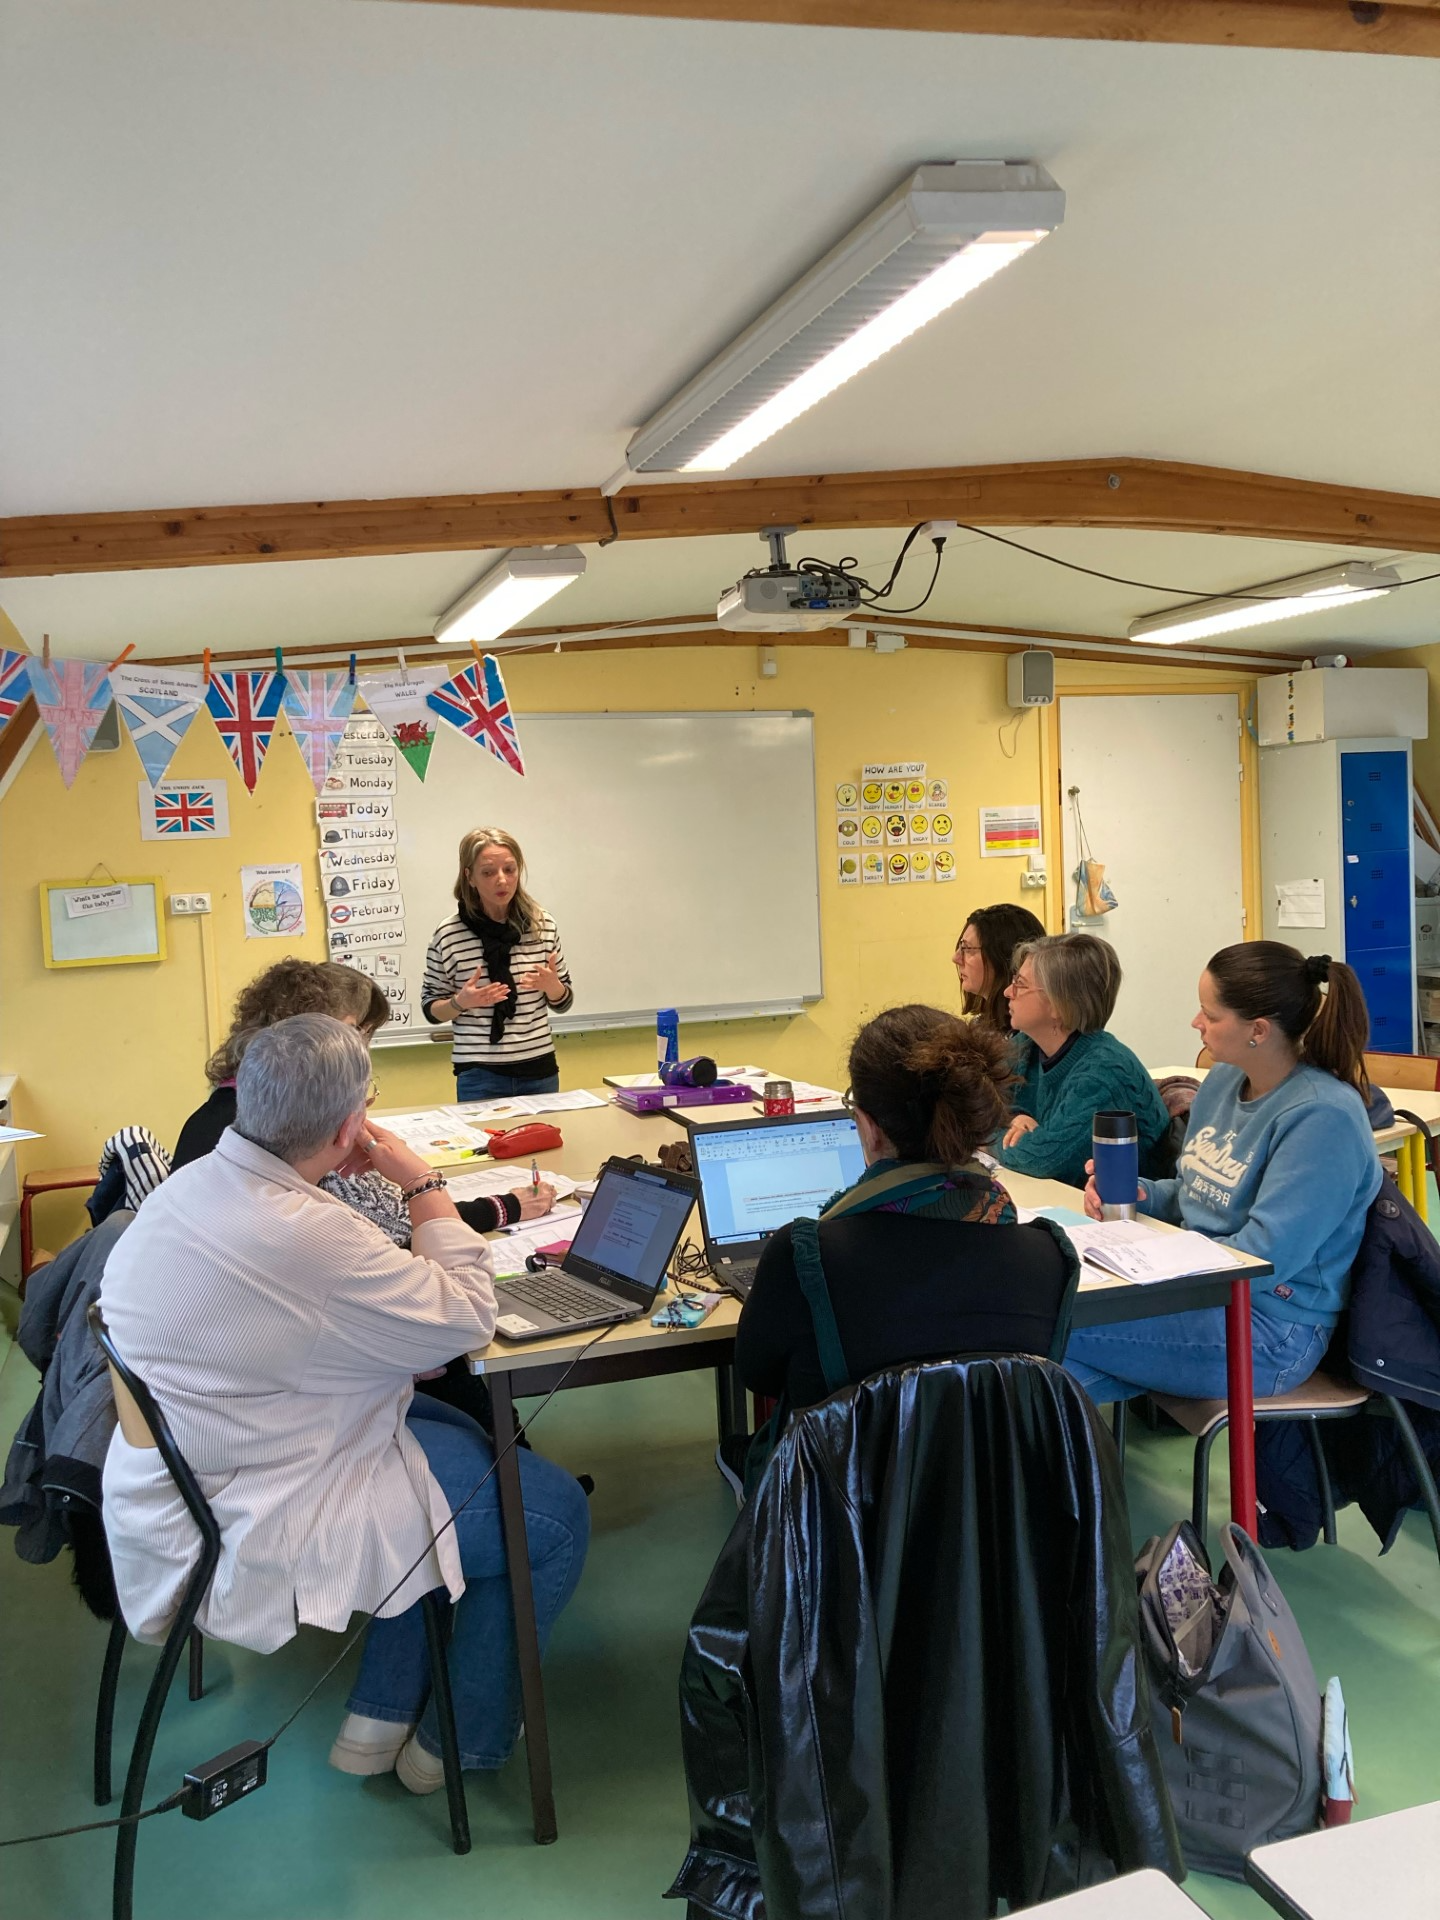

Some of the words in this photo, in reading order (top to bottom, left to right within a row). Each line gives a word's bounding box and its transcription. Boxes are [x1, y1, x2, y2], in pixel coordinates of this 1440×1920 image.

[120, 674, 133, 683] The
[133, 676, 150, 684] Cross
[152, 678, 159, 686] of
[160, 679, 175, 687] Saint
[176, 681, 198, 689] Andrew
[138, 686, 179, 697] SCOTLAND
[395, 690, 417, 698] WALES
[343, 729, 390, 741] esterda
[346, 754, 394, 767] Tuesday
[865, 766, 885, 774] HOW
[888, 765, 903, 773] ARE
[906, 764, 924, 773] YOU?
[350, 777, 394, 790] Monday
[347, 802, 389, 817] Today
[342, 828, 395, 840] Thursday
[331, 852, 396, 867] Wednesday
[352, 877, 395, 891] Friday
[351, 904, 400, 917] February
[346, 930, 403, 945] Tomorrow
[383, 986, 405, 1000] day
